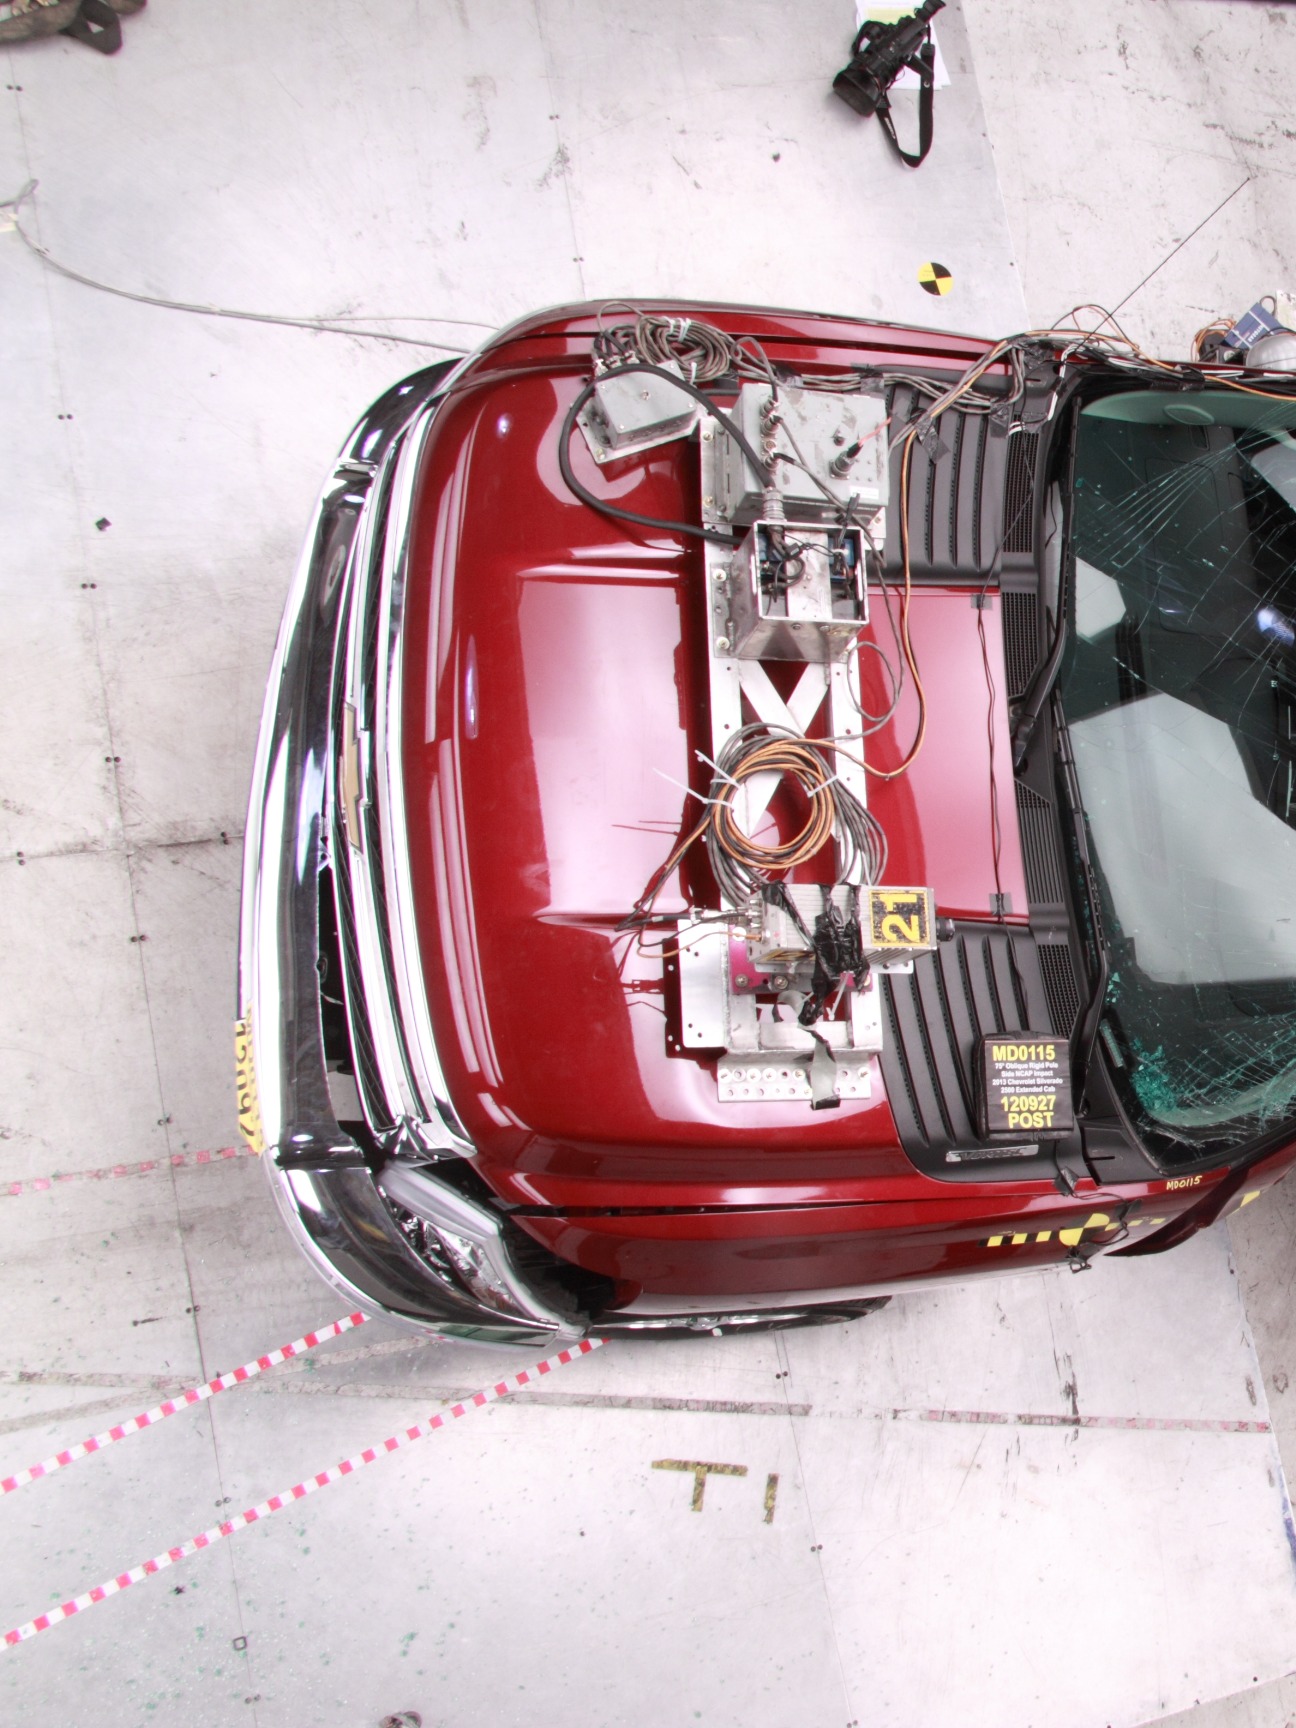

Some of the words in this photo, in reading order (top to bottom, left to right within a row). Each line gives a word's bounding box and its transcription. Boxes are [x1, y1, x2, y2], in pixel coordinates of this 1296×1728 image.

[879, 894, 920, 942] 21
[992, 1045, 1055, 1061] MD0115
[1000, 1095, 1056, 1111] 120927
[1008, 1111, 1054, 1128] POST
